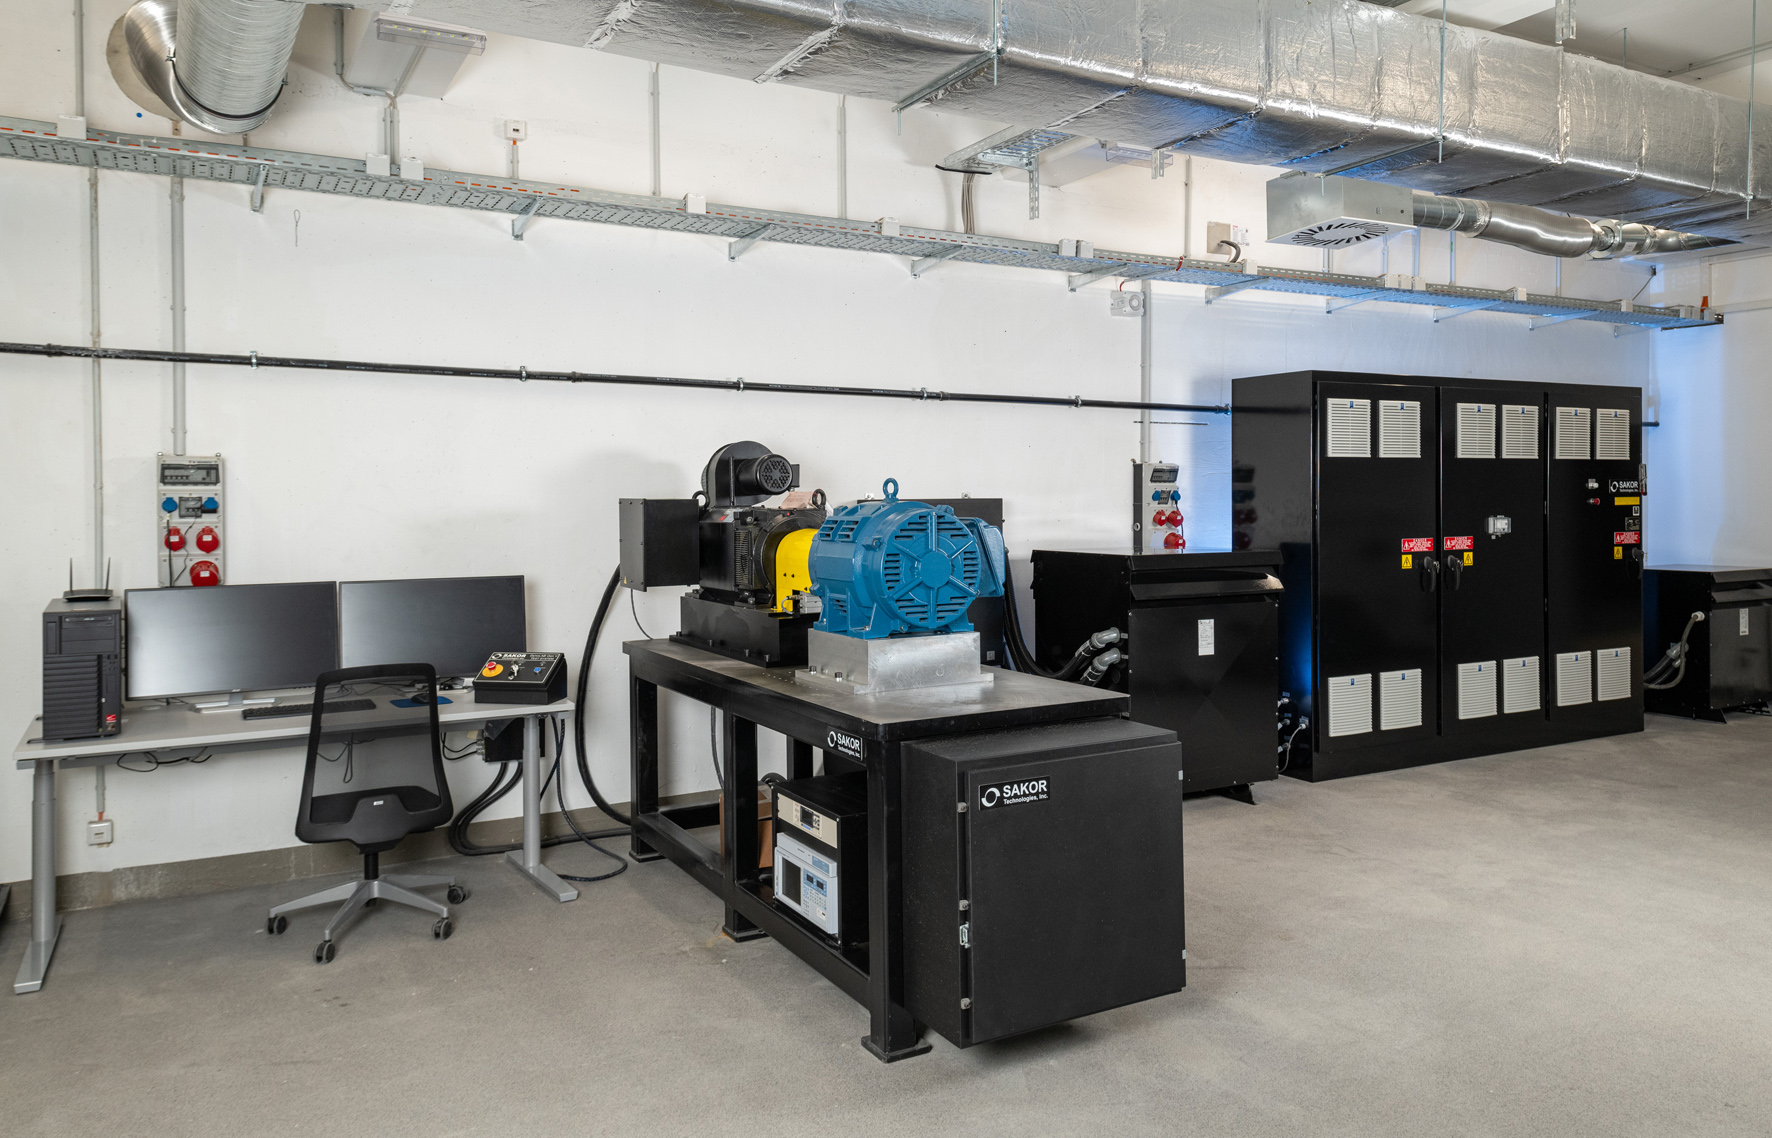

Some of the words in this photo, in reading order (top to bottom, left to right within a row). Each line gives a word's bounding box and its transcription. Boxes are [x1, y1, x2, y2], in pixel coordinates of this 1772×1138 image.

[1619, 481, 1638, 489] SAKOR
[837, 733, 861, 751] SAKOR
[1003, 780, 1048, 798] SAKOR
[1003, 794, 1039, 805] Technologies,
